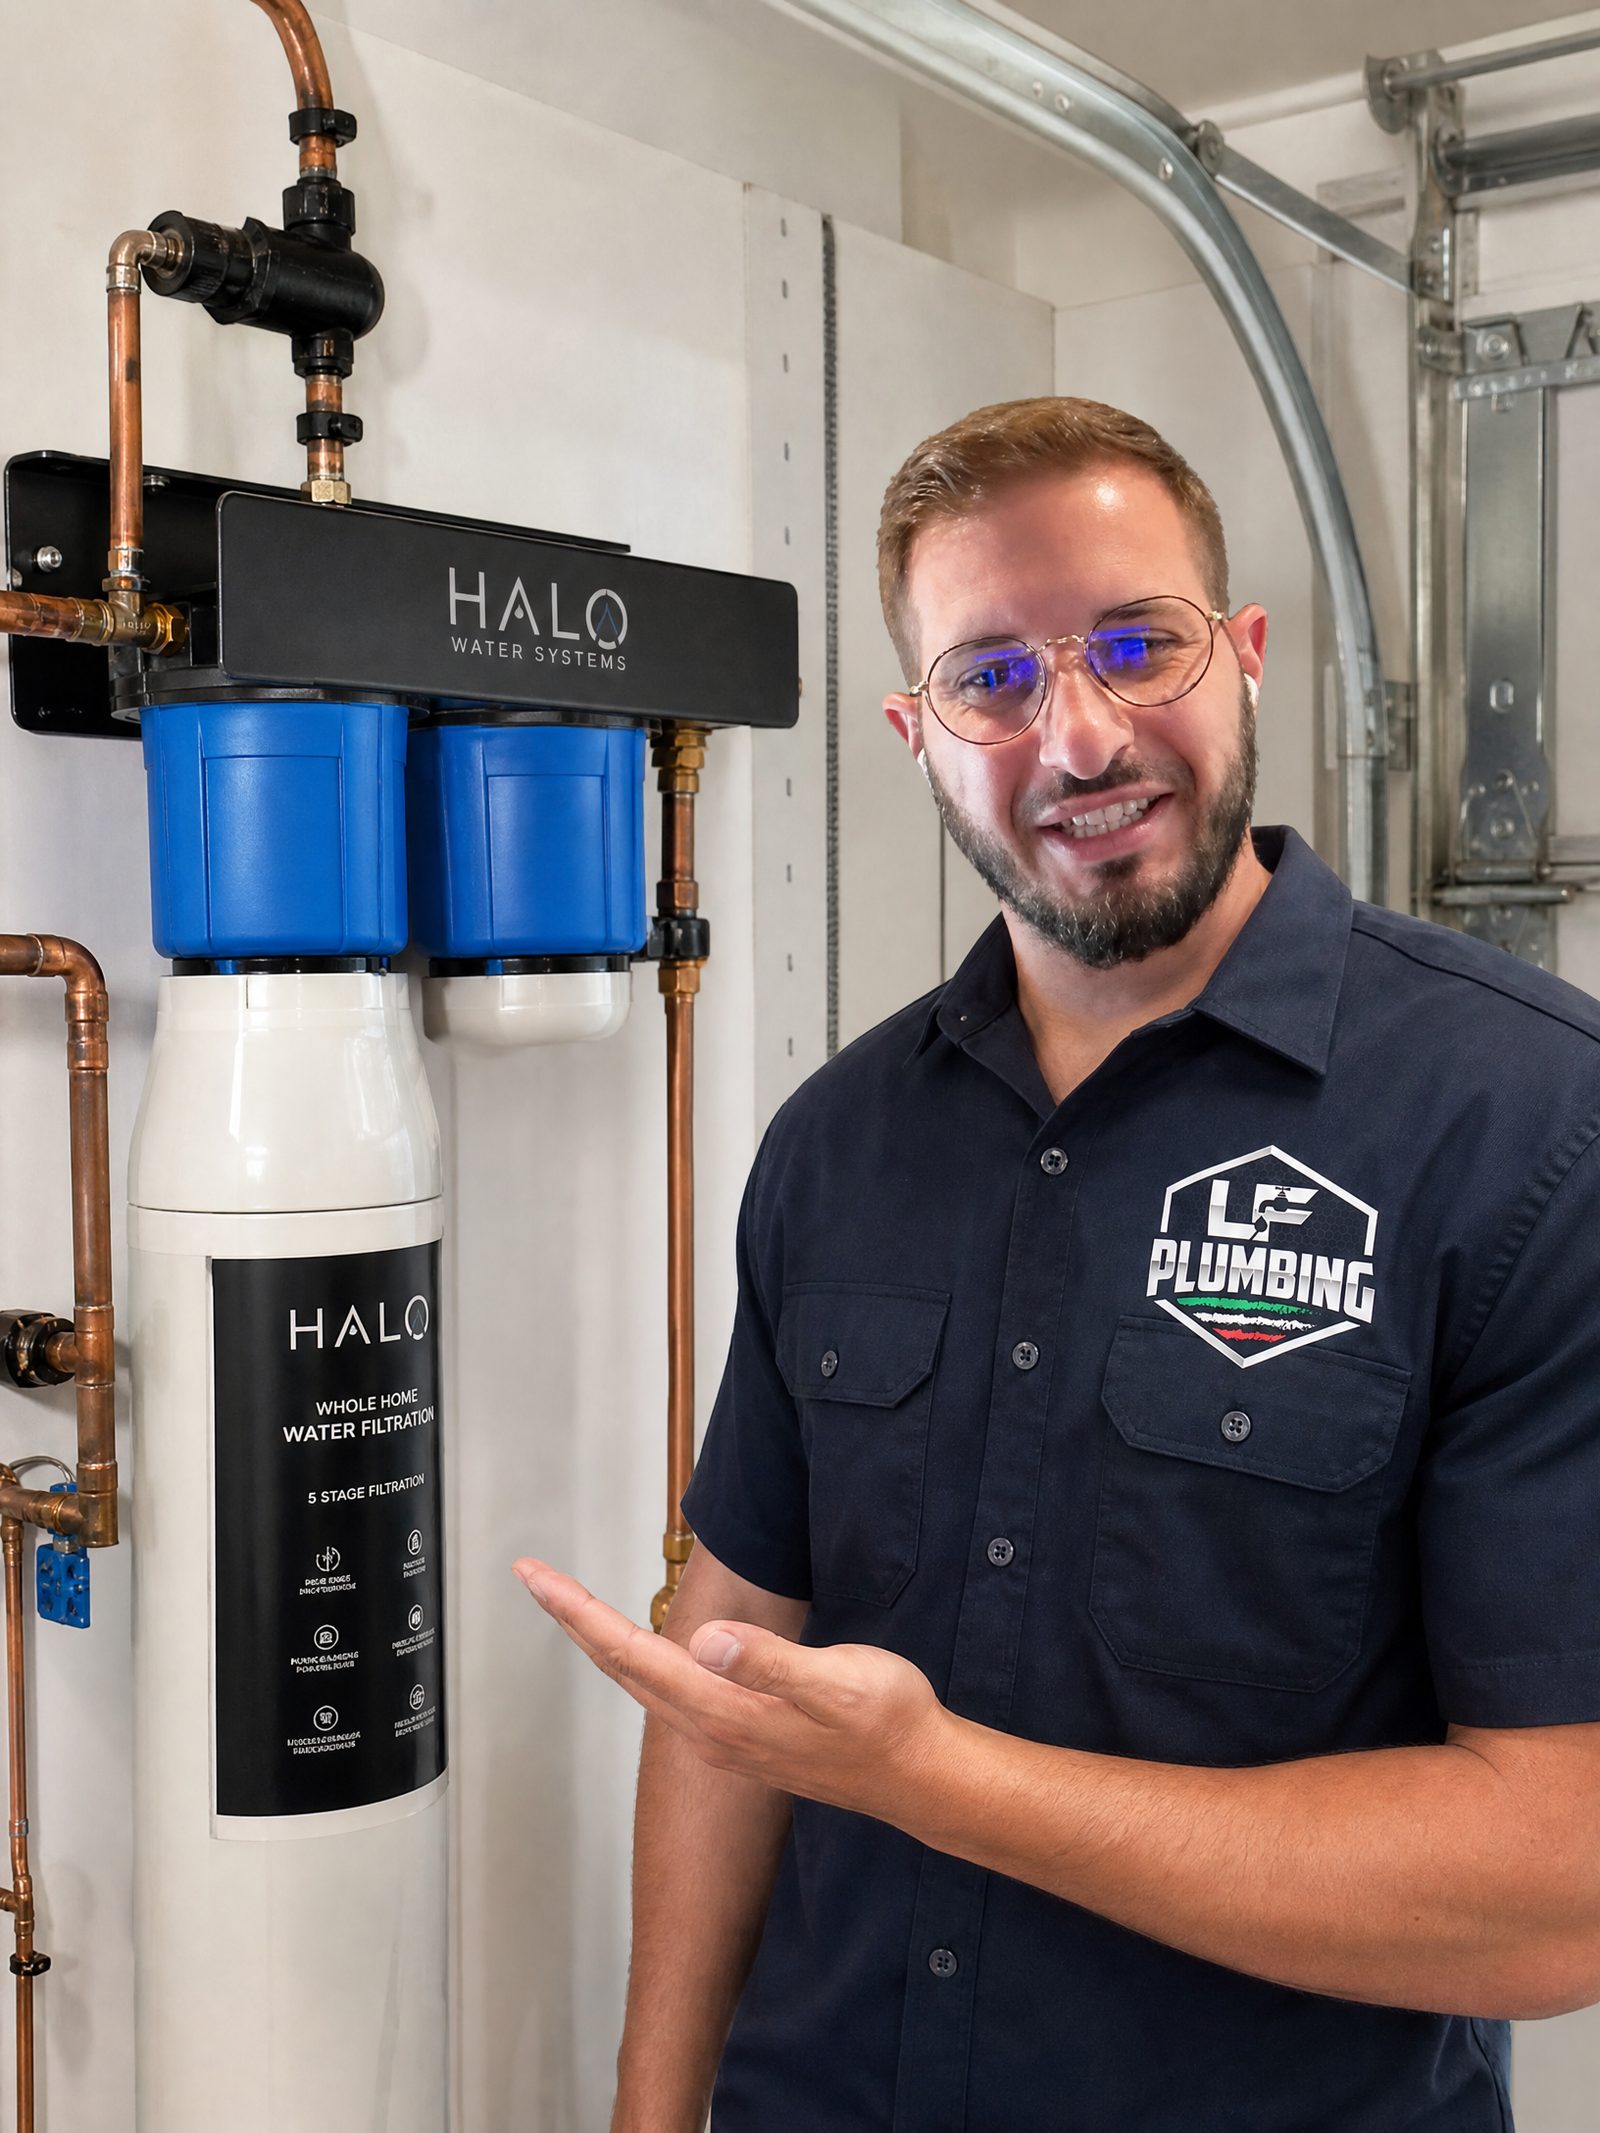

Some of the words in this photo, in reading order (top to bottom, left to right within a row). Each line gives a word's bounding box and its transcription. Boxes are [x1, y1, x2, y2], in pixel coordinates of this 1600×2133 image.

[449, 567, 628, 650] HALO
[451, 636, 523, 660] WATER
[535, 646, 626, 671] SYSTEMS
[1207, 1179, 1319, 1242] LF
[1146, 1238, 1376, 1324] PLUMBING
[290, 1294, 429, 1350] HALO
[283, 1422, 356, 1442] WATER
[361, 1405, 434, 1437] FILTRATION
[316, 1396, 376, 1416] WHOLE
[381, 1388, 418, 1407] HOME
[308, 1492, 316, 1504] 5
[321, 1486, 365, 1503] STAGE
[369, 1473, 425, 1497] FILTRATION
